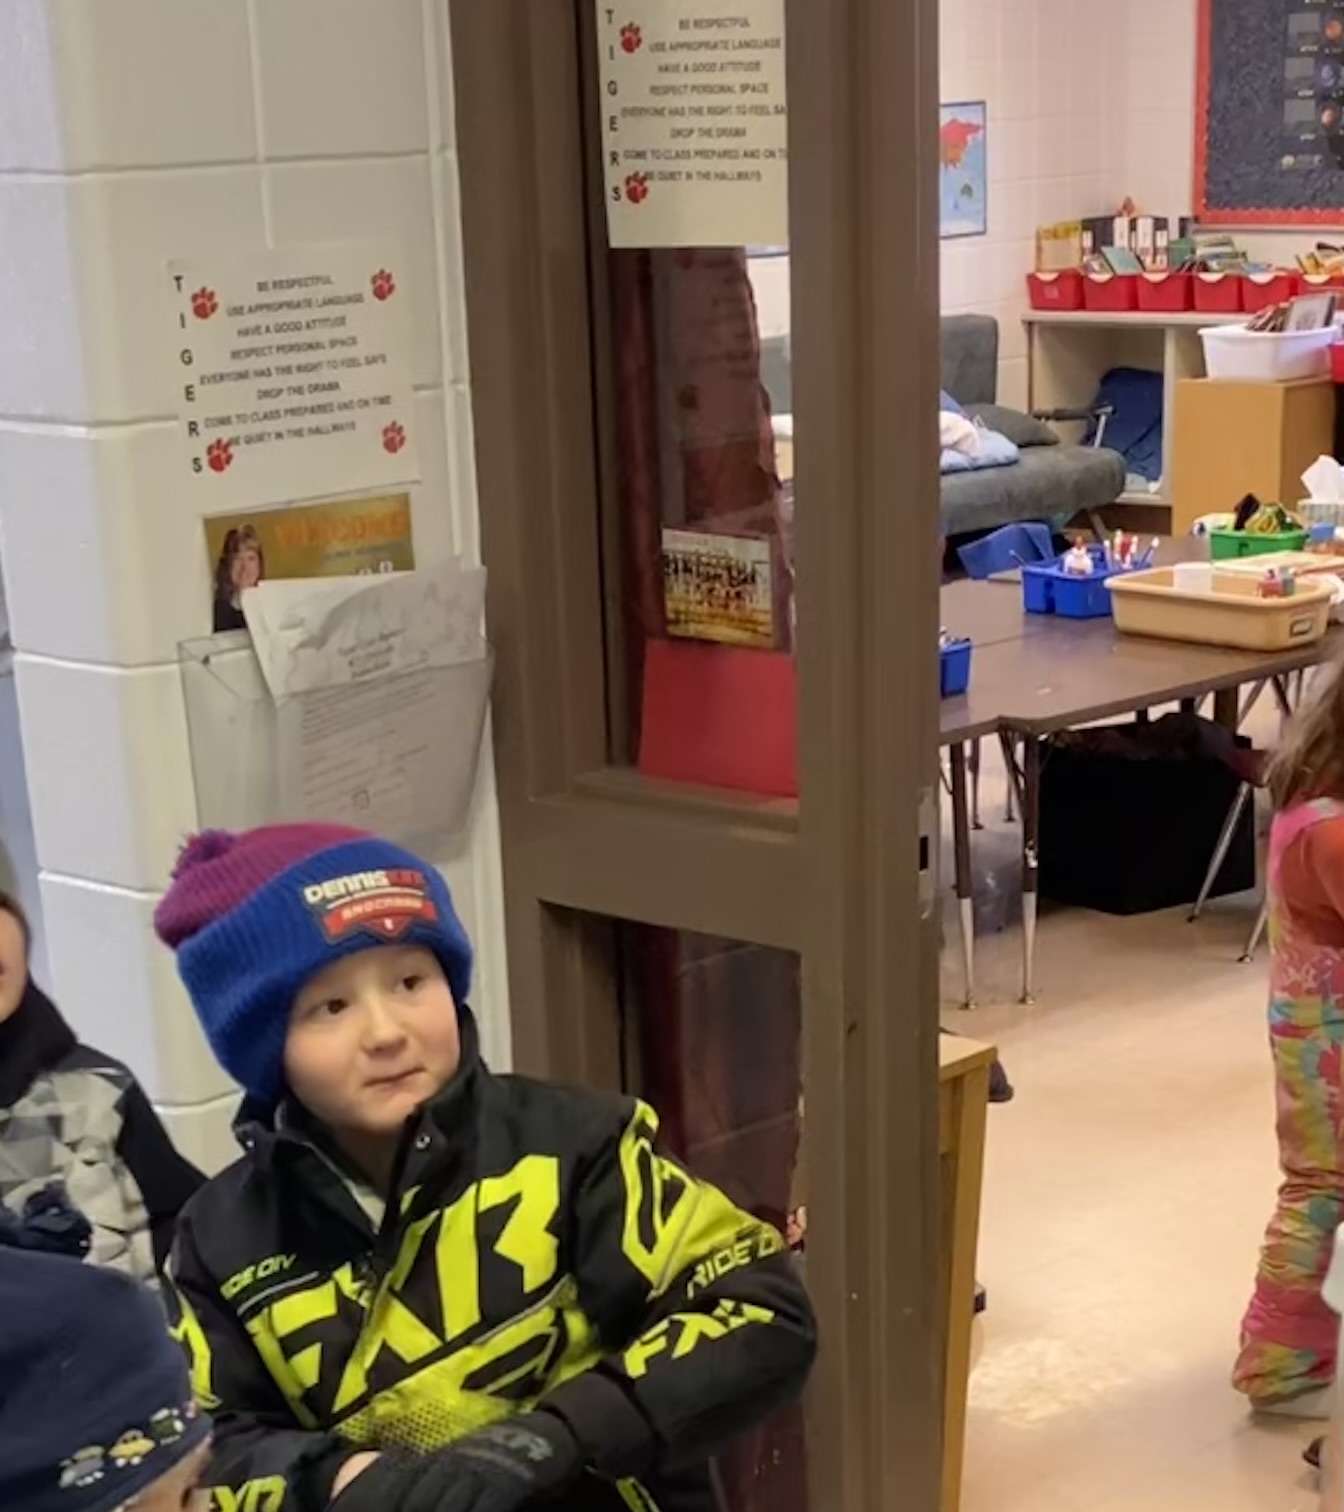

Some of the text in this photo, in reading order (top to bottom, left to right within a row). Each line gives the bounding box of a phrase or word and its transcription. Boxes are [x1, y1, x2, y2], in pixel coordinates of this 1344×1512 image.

[678, 17, 751, 30] BE RESPECTFUL
[649, 37, 781, 53] USE APPROPRIATE LANGUAGE
[658, 63, 680, 74] HAVE
[692, 62, 717, 74] GOOD
[719, 60, 761, 73] ATTITUDE
[649, 82, 769, 97] RESPECT PERSONAL SPACE
[620, 106, 666, 118] EVERYONE
[668, 106, 686, 117] HAS
[688, 105, 704, 116] THE
[706, 105, 733, 116] RIGHT
[735, 104, 746, 116] TO
[670, 127, 747, 139] DROP THE DRAMA
[622, 149, 647, 160] COME
[650, 149, 661, 160] TO
[663, 149, 691, 160] CLASS
[694, 148, 740, 160] PREPARED
[742, 148, 761, 160] AND
[762, 148, 776, 159] ON
[657, 170, 682, 181] QUIET
[695, 170, 712, 181] THE
[714, 169, 762, 182] HALLWAYS
[257, 275, 334, 292] BE RESPECTFUL
[226, 293, 364, 317] USE APPROPRIATE LANGUAGE
[237, 324, 262, 337] HAVE
[274, 321, 302, 334] GOOD
[306, 315, 346, 330] ATTITUDE
[230, 336, 358, 360] RESPECT PERSONAL SPACE
[199, 353, 387, 386] EVERYONE HAS THE RIGHT TO FEEL SAFE
[257, 381, 341, 400] DROP THE DRAMA
[205, 395, 392, 429] COME TO CLASS PREPARED AND ON TIME
[243, 431, 272, 445] QUIET
[274, 431, 284, 441] IN
[286, 427, 304, 438] THE
[306, 421, 357, 436] HALLWAYS
[303, 869, 391, 904] DENNIS
